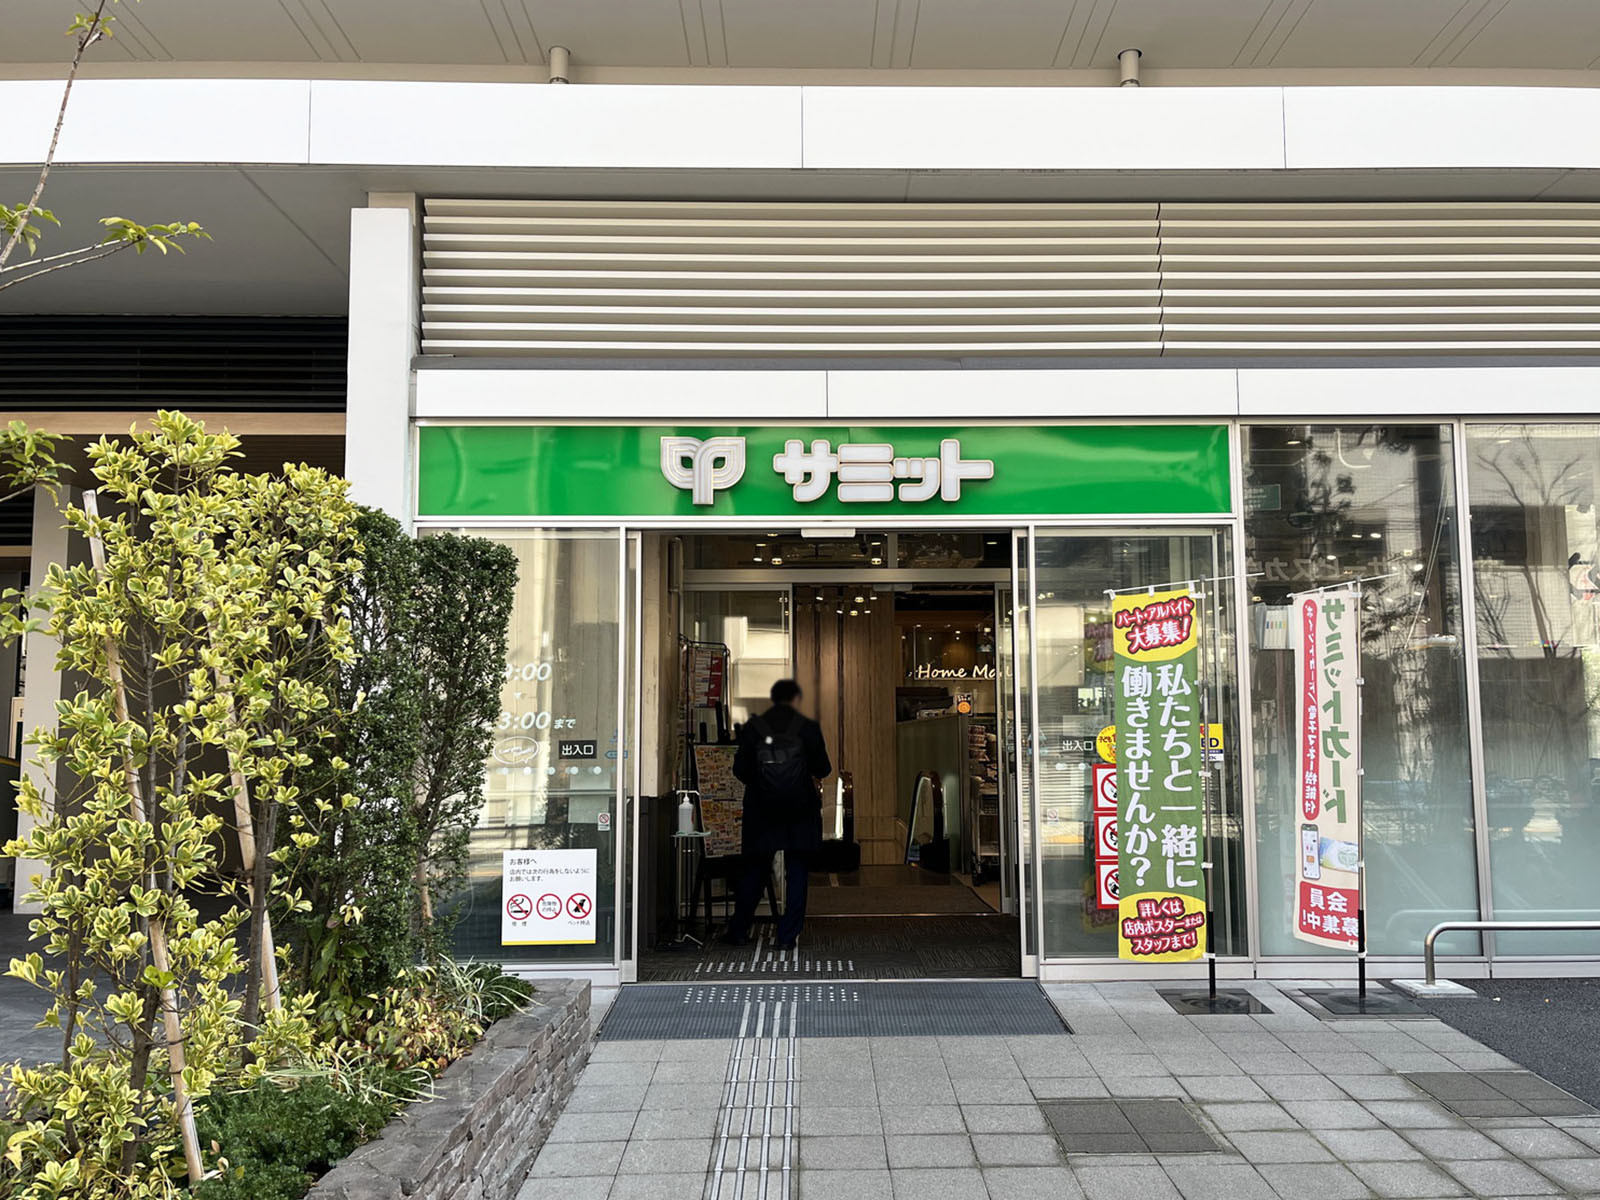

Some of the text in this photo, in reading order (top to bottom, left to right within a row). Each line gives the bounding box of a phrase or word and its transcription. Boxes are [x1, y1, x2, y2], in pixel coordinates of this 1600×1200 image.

[773, 439, 994, 502] サミット
[1117, 598, 1192, 626] パート・アルバイト
[1129, 617, 1190, 650] 大募集!
[918, 664, 967, 679] Home
[498, 711, 577, 730] 3:00 まで
[562, 744, 594, 756] 出入口
[1062, 740, 1094, 751] 出入口
[1121, 665, 1157, 887] 働きませんか?
[1156, 663, 1198, 889] 私たちと一緒に
[509, 858, 537, 866] お客様へ
[1140, 899, 1183, 918] 詳しくは
[1124, 915, 1203, 936] 店内ポスターまたは
[1132, 933, 1197, 952] スタッフまで!
